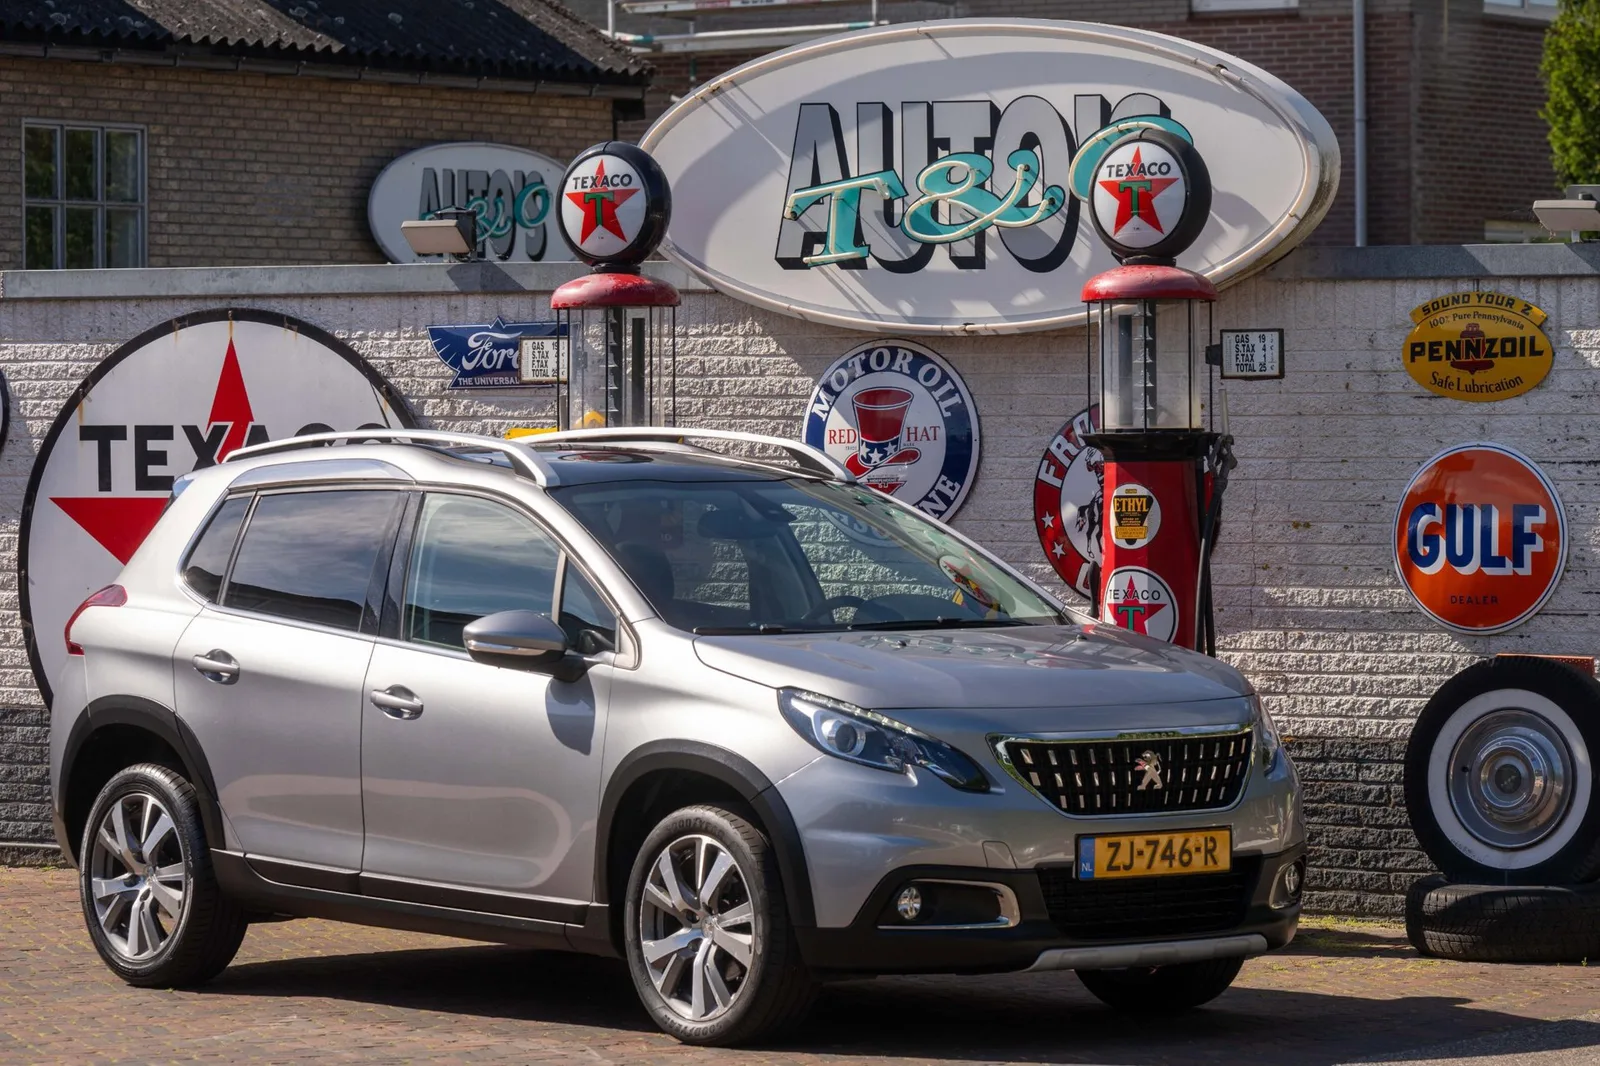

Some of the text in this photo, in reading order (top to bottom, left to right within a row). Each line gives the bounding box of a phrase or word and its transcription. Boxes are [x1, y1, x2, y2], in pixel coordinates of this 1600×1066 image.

[1106, 162, 1172, 178] TEXACO
[572, 173, 633, 190] TEXACO
[774, 93, 1172, 275] AUTO'
[1422, 293, 1471, 316] SOUND
[1475, 293, 1516, 308] YOUR
[1452, 312, 1472, 322] Pure
[1472, 310, 1525, 331] Pennsylvania
[1234, 334, 1250, 344] GAS
[1258, 333, 1266, 343] 19
[531, 341, 545, 350] GAS
[1234, 343, 1256, 353] S.TAX
[1261, 344, 1267, 353] 4
[1410, 335, 1544, 363] PENNZOIL
[531, 350, 550, 360] S.TAX
[1235, 353, 1255, 362] F.TAX
[531, 359, 549, 369] F.TAX
[1235, 363, 1256, 373] TOTAL
[1258, 362, 1267, 372] 25
[531, 368, 550, 378] TOTAL
[458, 376, 520, 386] THE UNIVERSAL
[811, 348, 963, 422] MOTOR OIL
[1429, 371, 1525, 393] Safe Lubrication
[828, 425, 940, 445] RED HAT
[1113, 497, 1149, 512] ETHYL
[1408, 502, 1547, 575] GULF
[1109, 589, 1161, 601] TEXACO
[1450, 595, 1499, 605] DEALER
[1106, 835, 1218, 872] ZJ-746-R
[1081, 863, 1093, 872] NL
